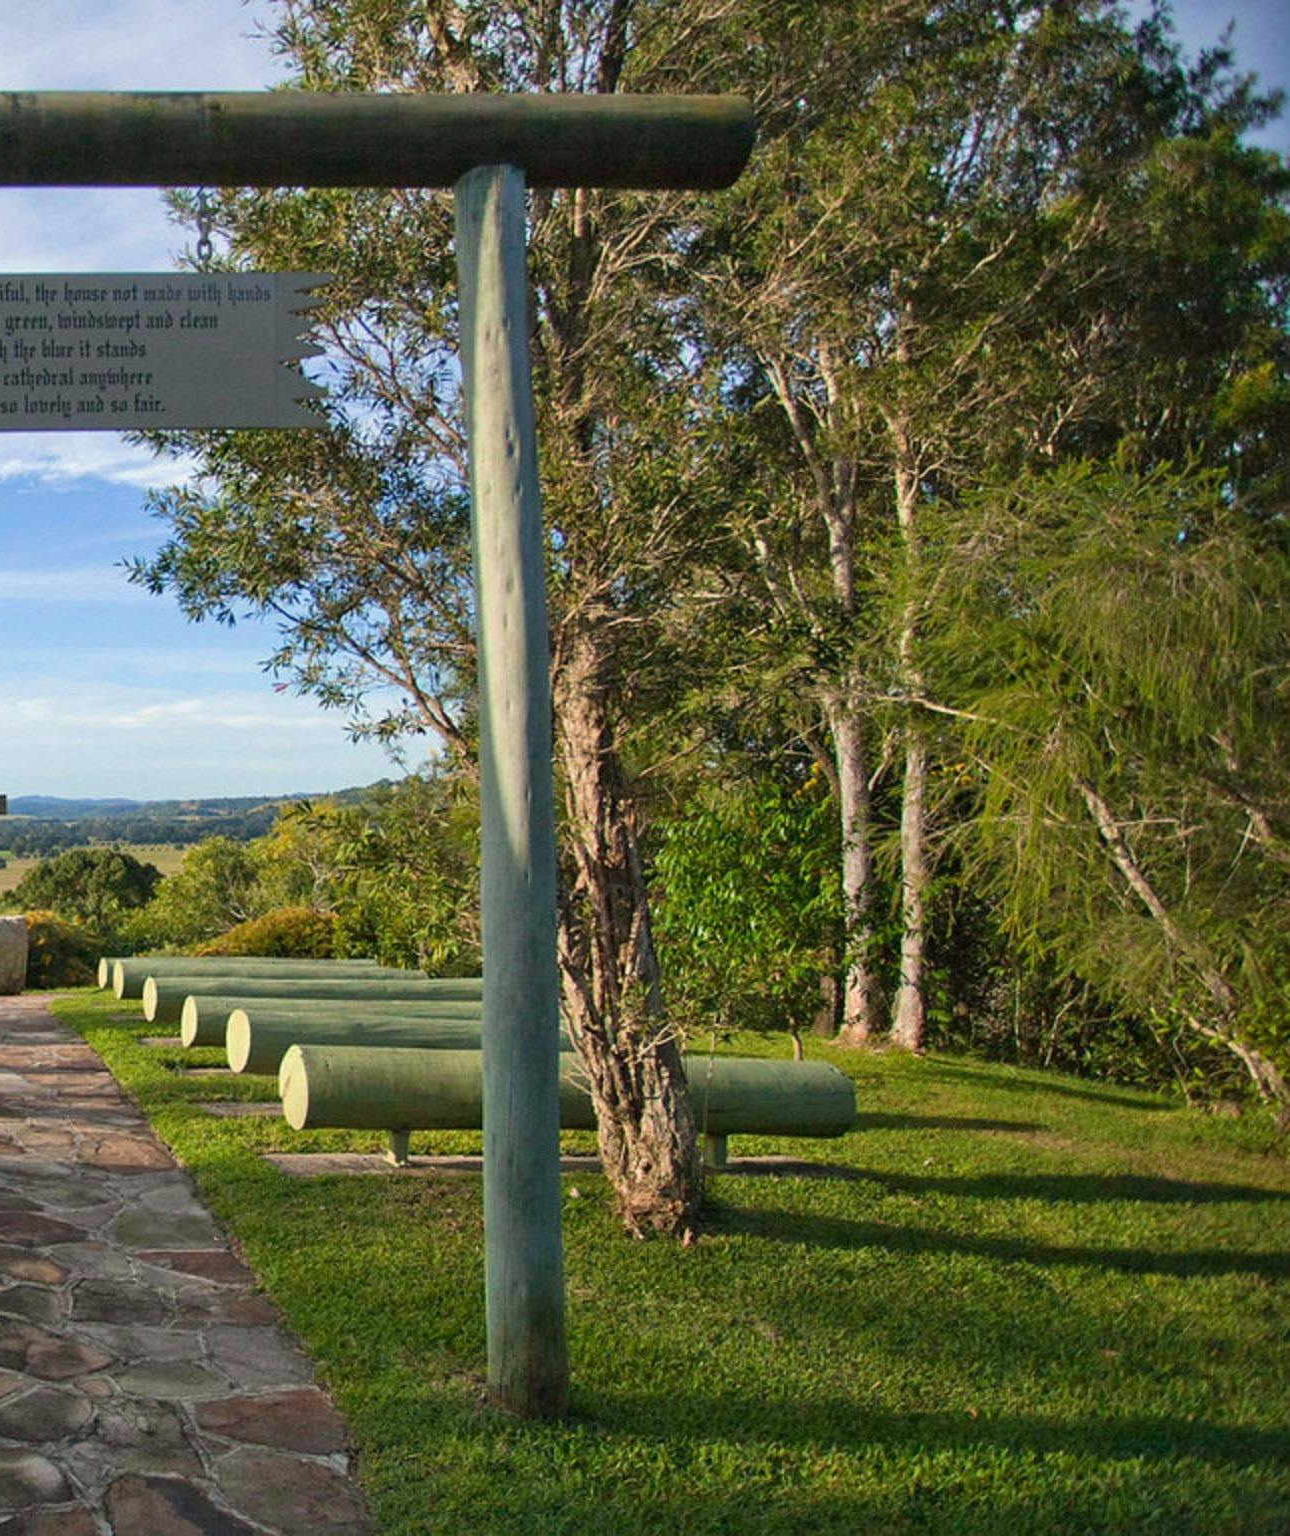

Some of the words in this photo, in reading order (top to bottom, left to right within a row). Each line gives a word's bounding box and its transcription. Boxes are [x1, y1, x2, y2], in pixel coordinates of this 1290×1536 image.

[34, 282, 58, 307] the
[64, 283, 108, 306] house
[113, 284, 138, 301] not
[144, 283, 183, 301] made
[188, 283, 222, 306] with
[228, 283, 271, 306] hands
[5, 315, 53, 336] green,
[58, 310, 141, 334] windswept
[146, 310, 174, 330] and
[179, 310, 219, 329] clean
[13, 338, 37, 363] the
[41, 339, 74, 359] blue
[79, 340, 91, 359] it
[96, 338, 147, 358] stands
[3, 366, 75, 391] cathedral
[79, 366, 154, 391] anywhere
[0, 400, 19, 415] so
[24, 394, 72, 419] lovely
[76, 394, 105, 414] and
[110, 400, 128, 414] so
[133, 392, 167, 414] fair.
